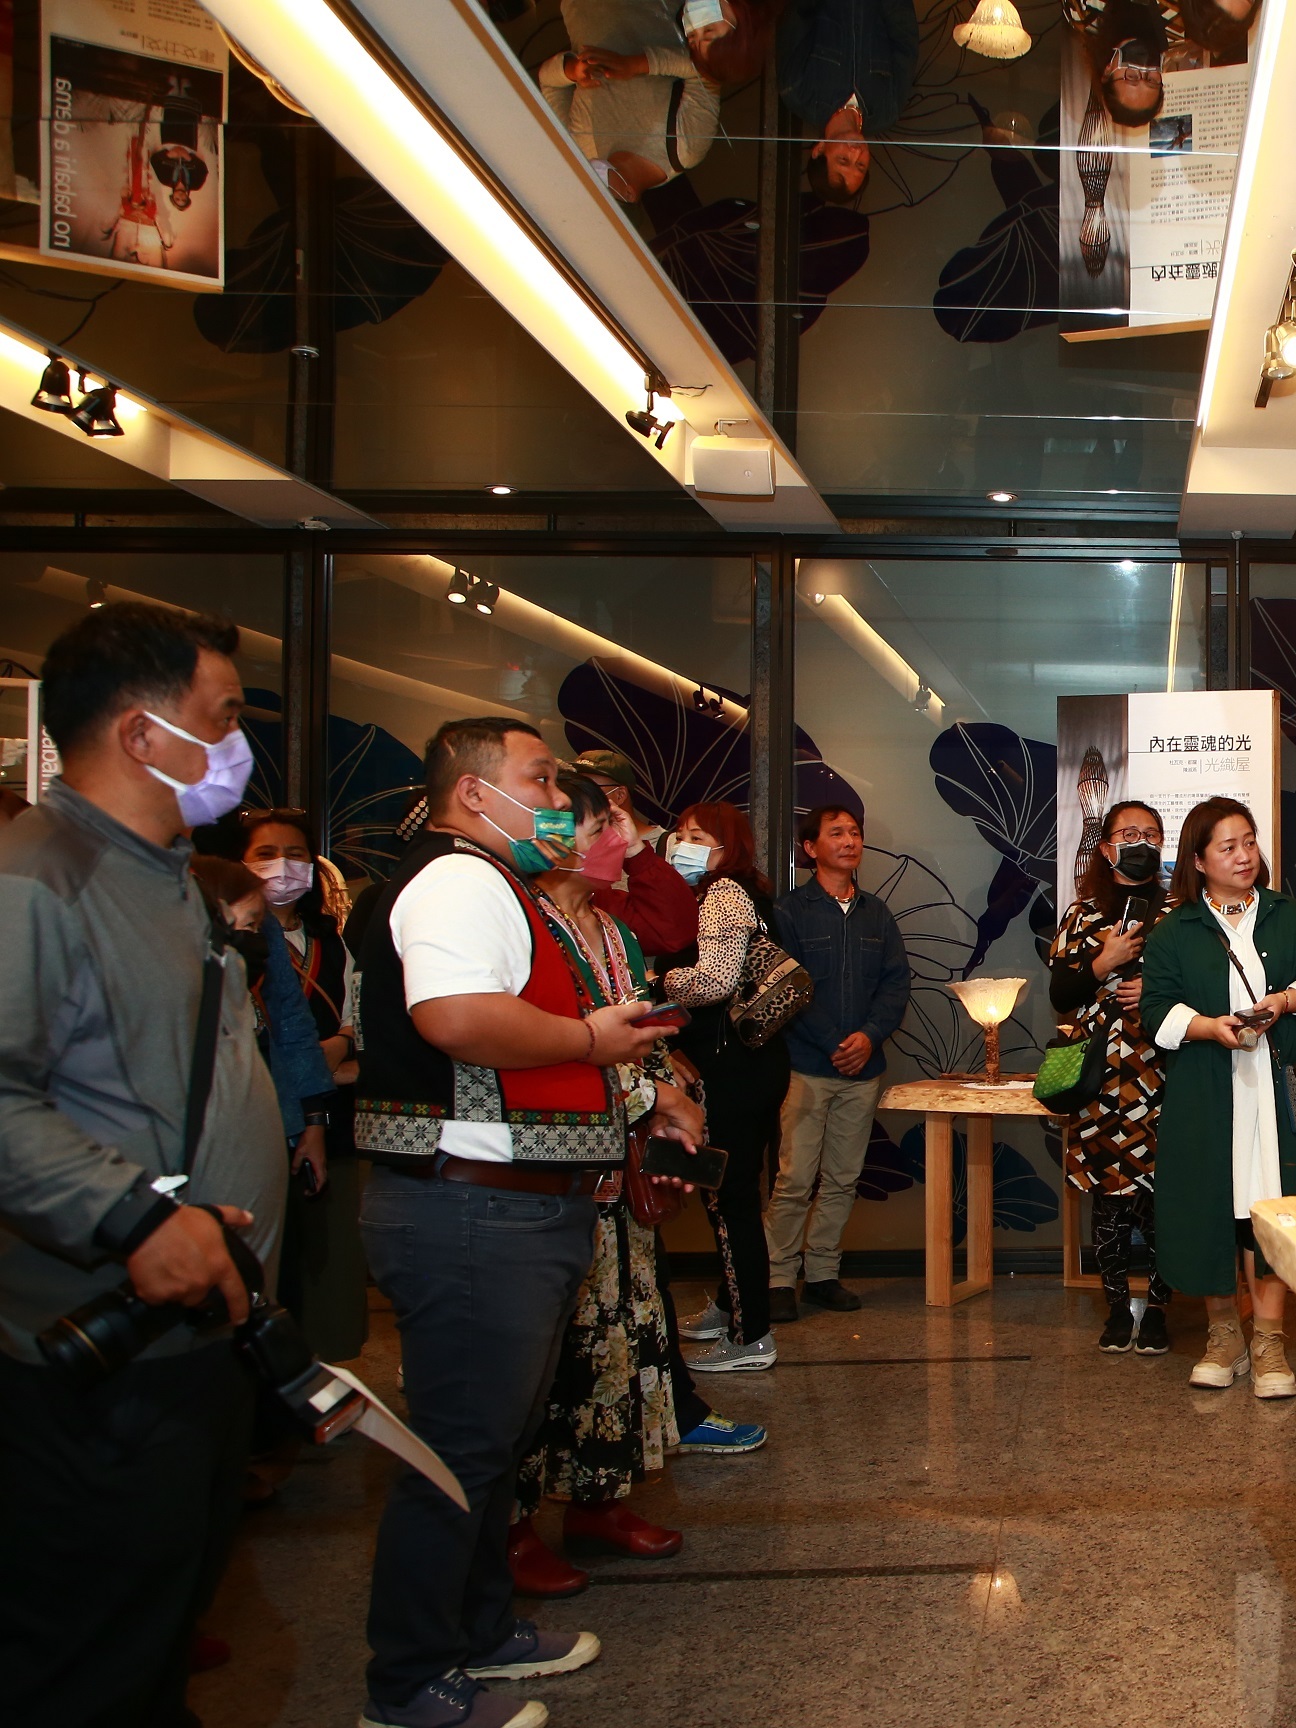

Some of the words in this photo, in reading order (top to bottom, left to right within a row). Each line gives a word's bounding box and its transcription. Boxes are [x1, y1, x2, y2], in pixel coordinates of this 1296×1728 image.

[1149, 733, 1252, 752] 內在靈魂的光
[1204, 756, 1251, 773] 光織屋
